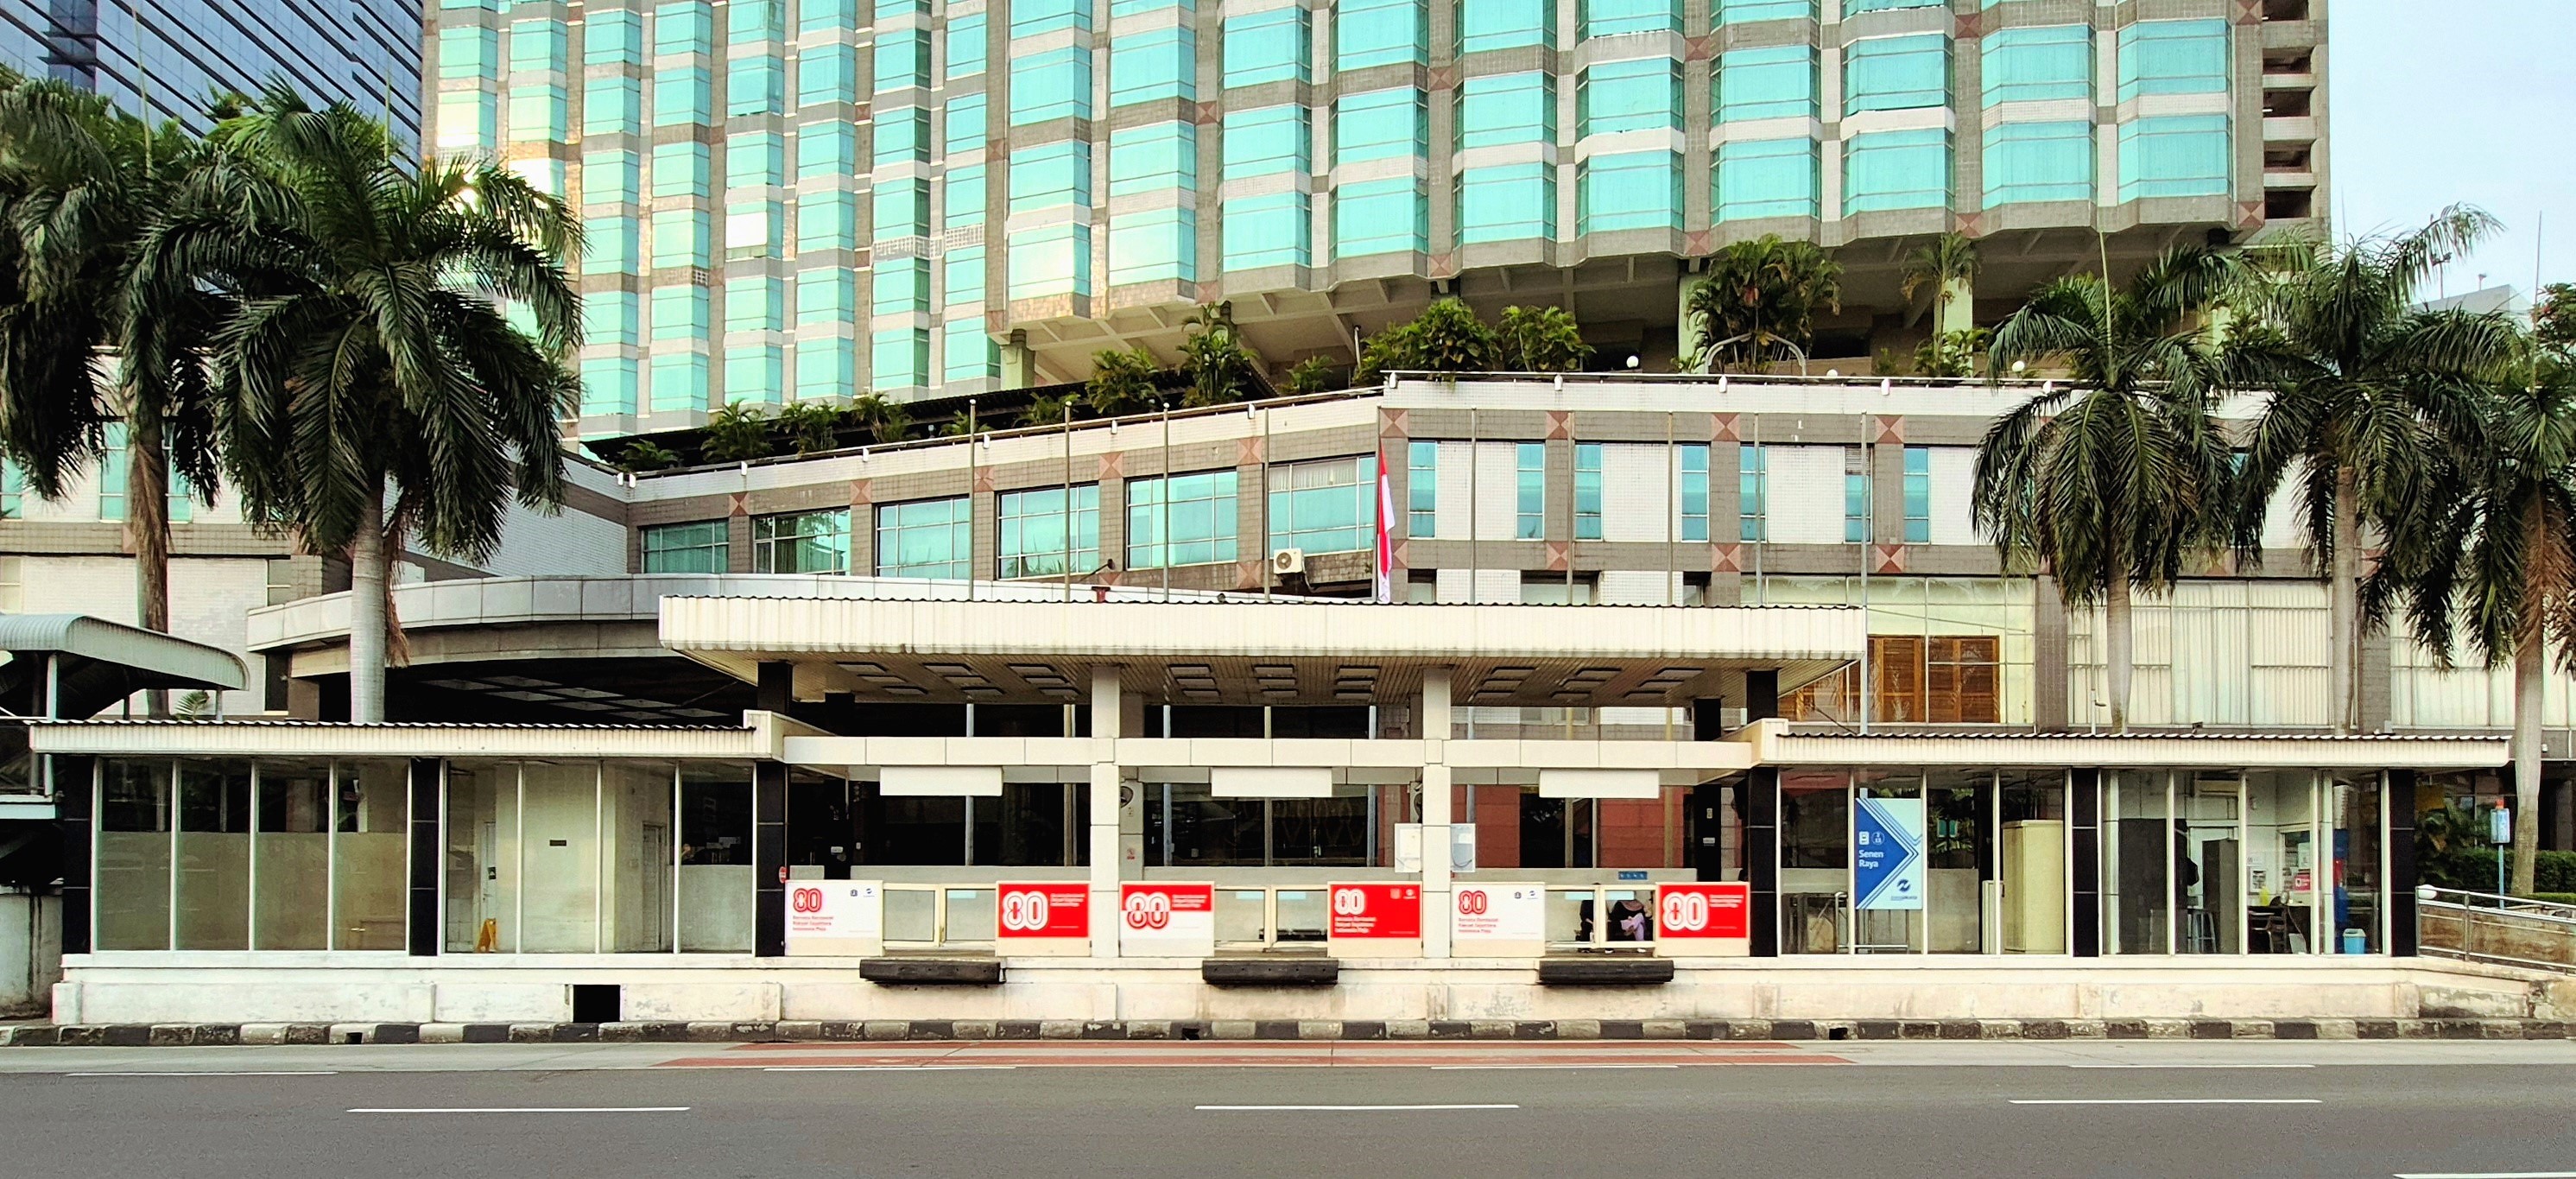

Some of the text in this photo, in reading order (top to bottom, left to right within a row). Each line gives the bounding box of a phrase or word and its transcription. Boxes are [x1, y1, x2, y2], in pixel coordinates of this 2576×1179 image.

[1858, 850, 1884, 859] Senen
[1858, 859, 1879, 870] Raya
[793, 888, 822, 913] 80
[1002, 891, 1048, 931] 80
[1125, 891, 1171, 929] 80
[1334, 888, 1366, 916] 80
[1459, 891, 1487, 915] 80
[1662, 891, 1709, 931] 80
